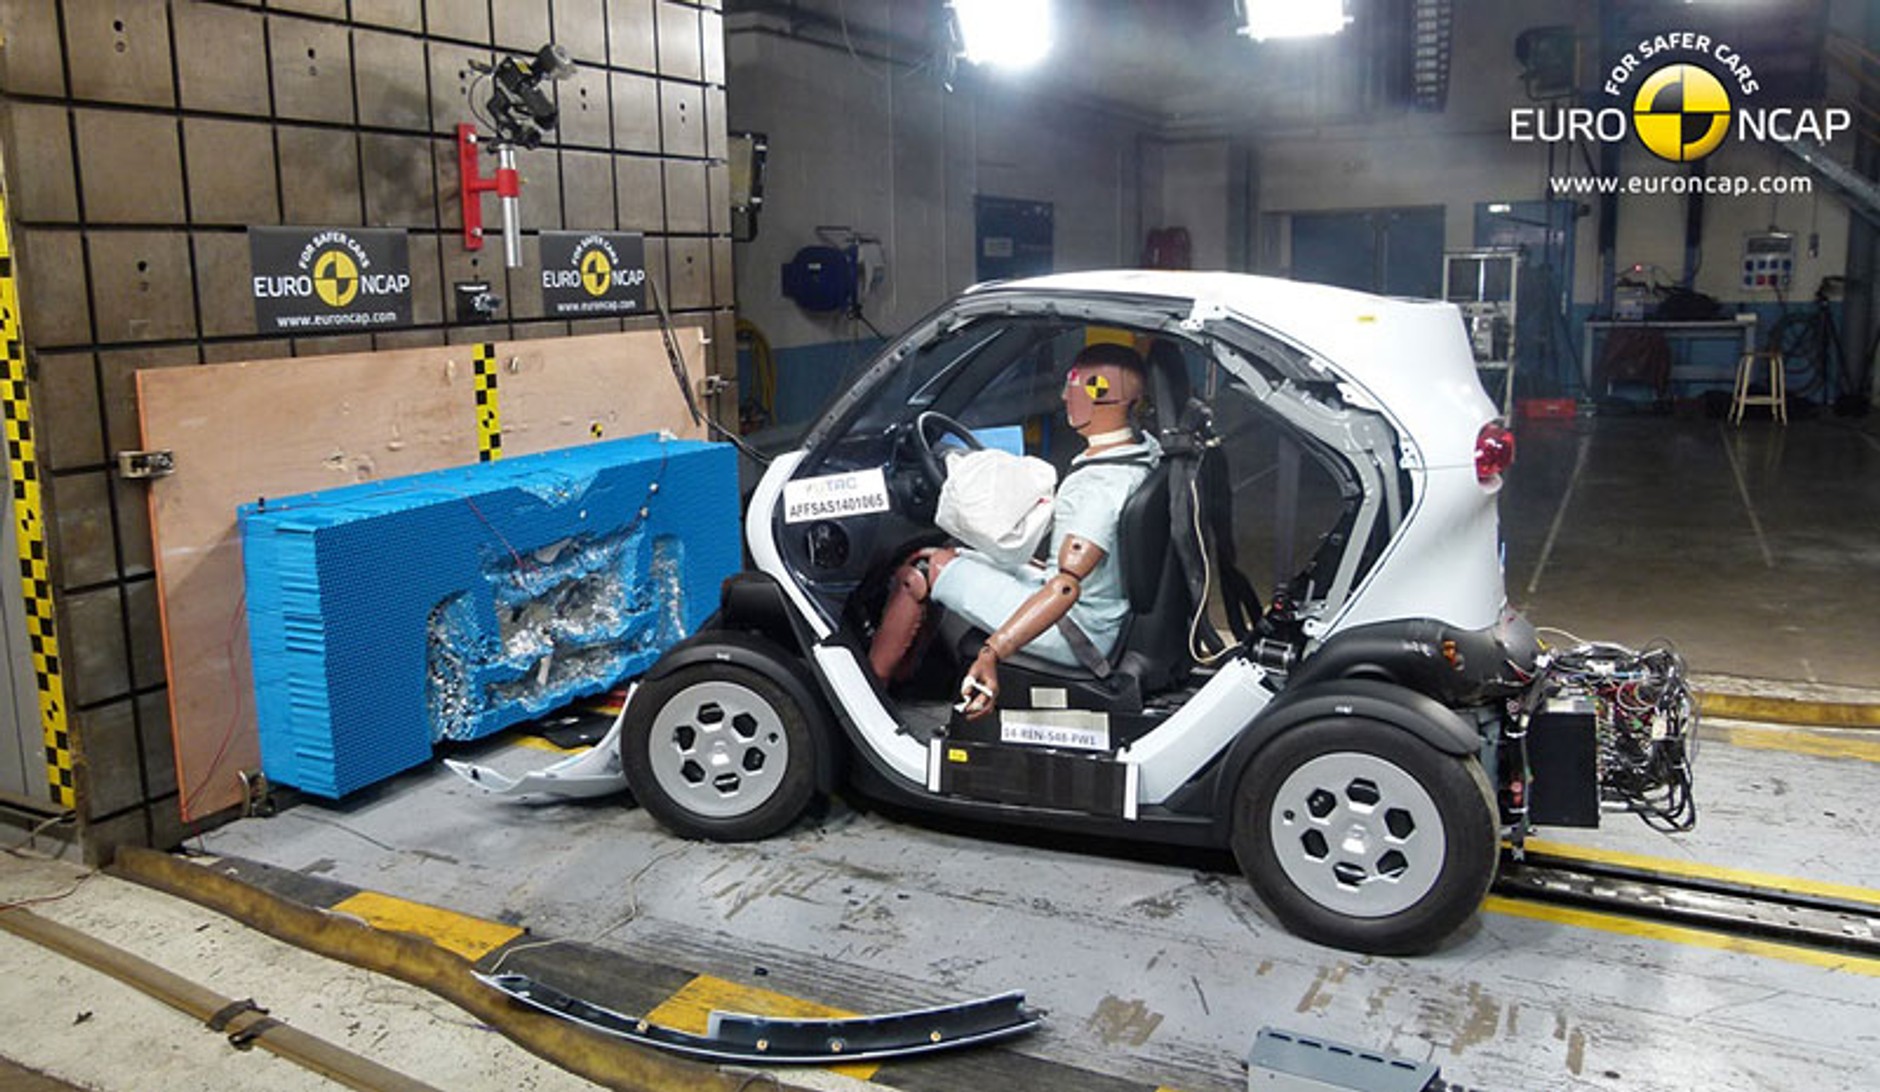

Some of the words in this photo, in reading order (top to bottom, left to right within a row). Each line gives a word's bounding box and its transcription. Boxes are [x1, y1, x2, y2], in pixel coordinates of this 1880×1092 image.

[298, 243, 316, 269] FOR
[312, 232, 347, 248] SAFER
[347, 239, 370, 268] CARS
[253, 275, 313, 298] EURO
[361, 274, 411, 295] NCAP
[542, 269, 581, 288] EURO
[612, 269, 645, 286] NCAP
[276, 311, 397, 328] www.euroncap.com
